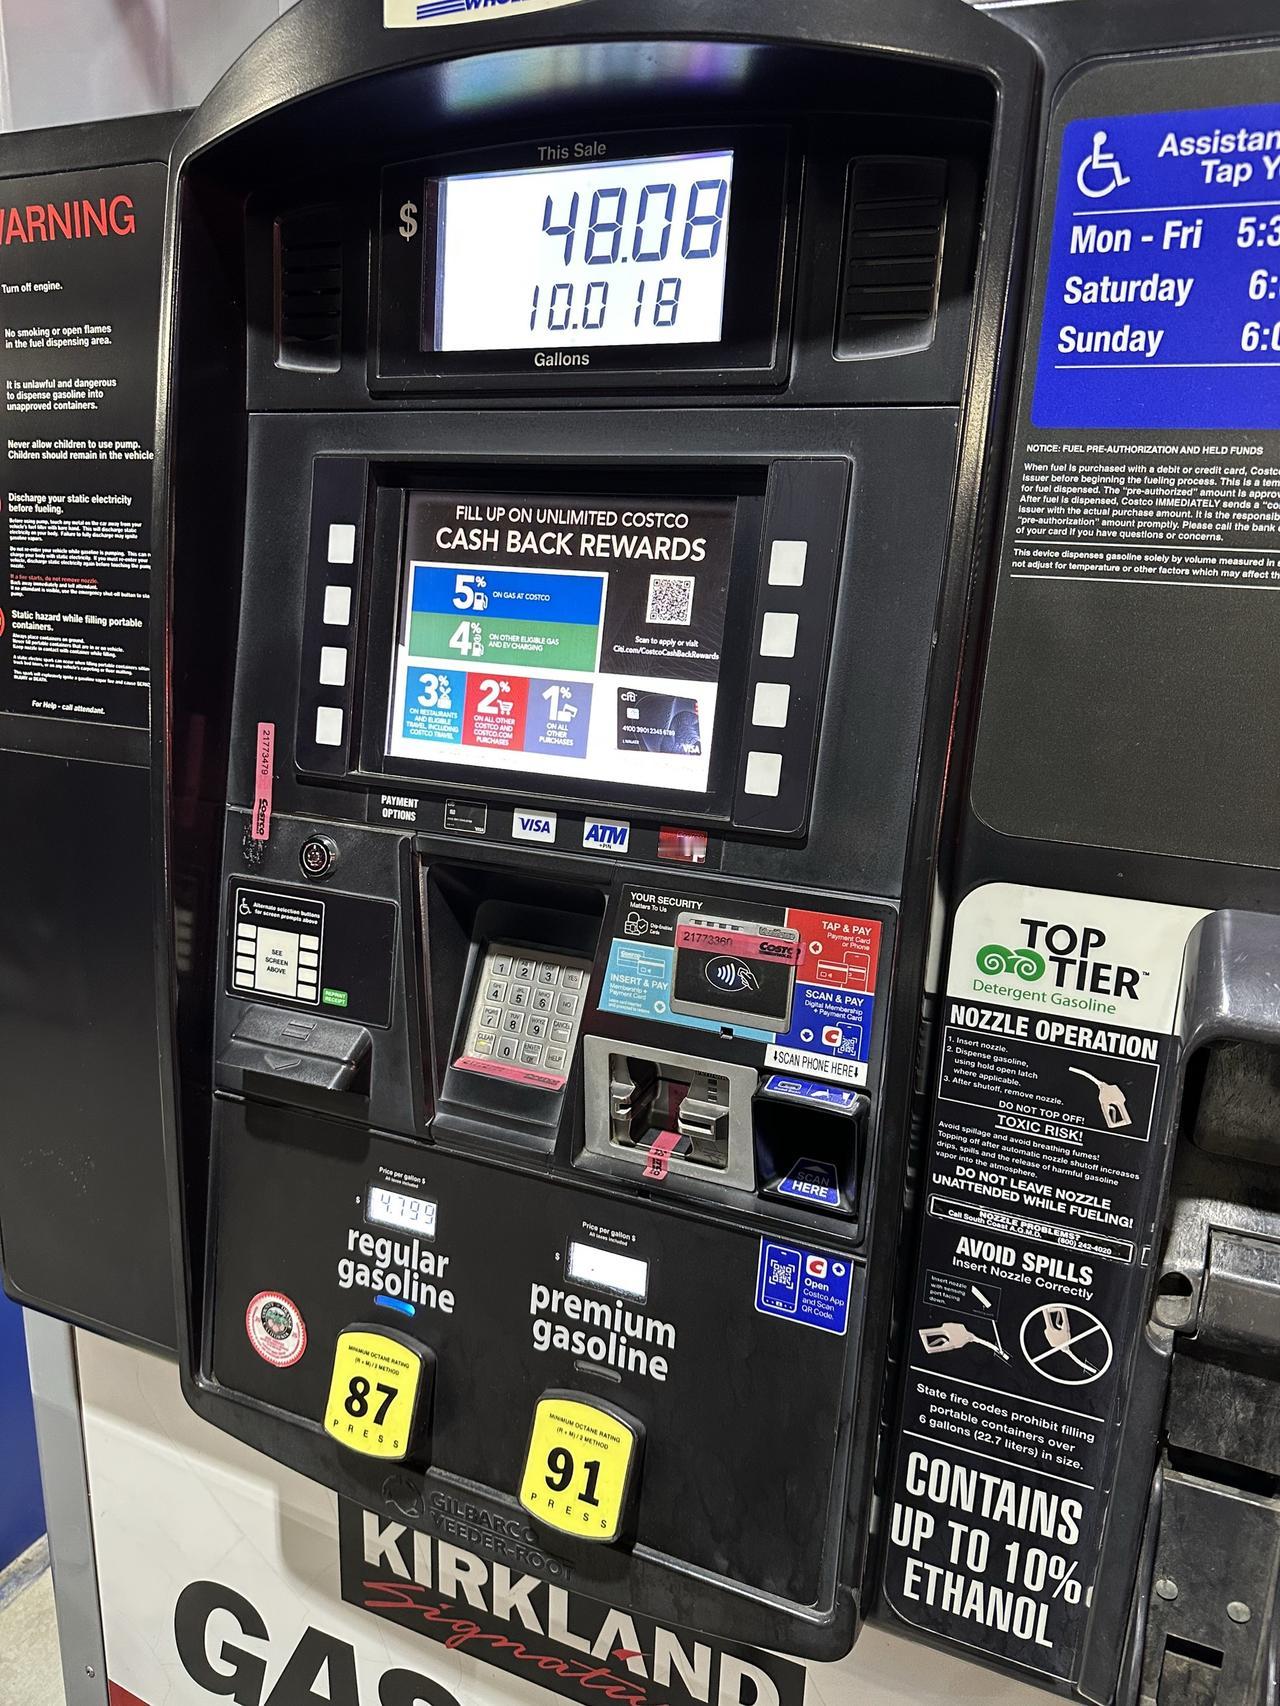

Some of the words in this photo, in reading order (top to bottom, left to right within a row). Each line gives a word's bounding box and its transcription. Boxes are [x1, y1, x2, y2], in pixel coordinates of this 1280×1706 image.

[538, 146, 569, 162] This
[574, 142, 606, 157] Sale
[1200, 160, 1253, 187] Tap
[0, 195, 136, 245] ARNING
[399, 200, 417, 242] $
[542, 179, 728, 266] 48.08
[1070, 225, 1131, 254] Mon
[1162, 219, 1203, 250] Fri
[1, 284, 19, 294] Turn
[21, 283, 32, 292] off
[34, 281, 63, 292] engine.
[1064, 273, 1194, 307] Saturday
[5, 328, 16, 337] No
[18, 327, 50, 339] smoking
[52, 328, 60, 336] or
[62, 327, 82, 337] open
[84, 324, 112, 334] flames
[1058, 325, 1164, 357] Sunday
[534, 353, 590, 367] Gallons
[1026, 444, 1060, 453] NOTICE:
[1063, 445, 1084, 453] FUEL
[1087, 445, 1179, 454] PRE-AUTHORIZATION
[1180, 446, 1200, 454] AND
[1202, 447, 1228, 455] HELD
[1230, 447, 1263, 455] FUNDS
[1024, 463, 1048, 472] When
[1050, 464, 1067, 472] fuel
[1069, 464, 1076, 472] is
[1079, 464, 1126, 475] purchased
[1128, 465, 1146, 473] with
[1157, 465, 1180, 474] debit
[1195, 467, 1221, 475] credit
[1224, 467, 1247, 476] card,
[9, 493, 46, 505] Discharge
[48, 495, 65, 504] your
[67, 494, 89, 503] static
[92, 495, 132, 506] electricity
[9, 504, 32, 513] before
[35, 504, 63, 514] fueling.
[456, 506, 483, 522] FILL
[486, 507, 505, 522] UP
[509, 509, 533, 523] ON
[536, 509, 618, 528] UNLIMITED
[621, 512, 689, 529] COSTCO
[436, 528, 499, 551] CASH
[506, 530, 573, 556] BACK
[580, 534, 707, 562] REWARDS
[493, 591, 501, 599] ON
[525, 593, 550, 602] COSTCO
[635, 636, 649, 644] Scan
[659, 639, 676, 647] apply
[32, 701, 41, 709] For
[43, 701, 57, 710] Help
[62, 703, 72, 711] call
[74, 705, 105, 714] attendant.
[621, 692, 636, 702] citi
[682, 744, 700, 753] VISA
[381, 795, 418, 809] PAYMENT
[382, 808, 416, 822] OPTIONS
[518, 817, 551, 834] VISA
[585, 824, 627, 845] ATM
[630, 892, 655, 904] YOUR
[657, 896, 703, 910] SECURITY
[822, 921, 841, 932] TAP
[844, 924, 851, 933] &
[853, 926, 872, 936] PAY
[1020, 918, 1106, 959] TOP
[265, 957, 288, 968] SCREEN
[266, 966, 286, 975] ABOVE
[611, 974, 642, 986] INSERT
[644, 978, 650, 987] &
[651, 981, 668, 991] PAY
[805, 989, 834, 1002] SCAN
[836, 995, 844, 1004] &
[846, 996, 864, 1007] PAY
[973, 979, 1047, 1003] Detergent
[1051, 993, 1116, 1015] Gasoline
[950, 1004, 1029, 1037] NOZZLE
[1035, 1020, 1158, 1060] OPERATION
[778, 1052, 800, 1066] SCAN
[802, 1056, 830, 1072] PHONE
[831, 1062, 854, 1078] HERE
[999, 1100, 1014, 1110] DO
[1016, 1103, 1038, 1115] NOT
[1040, 1109, 1060, 1120] TOP
[1062, 1113, 1085, 1124] OFF!
[997, 1114, 1041, 1133] TOXIC
[1045, 1124, 1084, 1142] RISK!
[379, 1167, 393, 1175] Price
[404, 1174, 421, 1183] gallon
[792, 1180, 828, 1198] HERE
[956, 1166, 975, 1179] DO
[978, 1171, 1006, 1187] NOT
[1010, 1178, 1052, 1197] LEAVE
[1055, 1188, 1111, 1210] NOZZLE
[933, 1173, 1020, 1203] UNATTENDED
[1023, 1194, 1066, 1214] WHILE
[1069, 1205, 1134, 1229] FUELING!
[347, 1229, 450, 1279] regular
[956, 1236, 1016, 1267] AVOID
[1022, 1252, 1093, 1286] SPILLS
[338, 1257, 455, 1314] gasoline
[804, 1278, 829, 1292] Open
[953, 1256, 987, 1274] Insert
[990, 1265, 1031, 1284] Nozzle
[1035, 1277, 1094, 1301] Correctly
[802, 1297, 815, 1307] and
[816, 1300, 834, 1312] Scan
[803, 1288, 829, 1301] Costco
[830, 1296, 844, 1307] App
[530, 1282, 677, 1350] premium
[802, 1305, 813, 1314] QR
[814, 1308, 834, 1320] Code.
[532, 1320, 668, 1381] gasoline
[345, 1376, 398, 1426] 87
[916, 1384, 947, 1400] State
[950, 1392, 969, 1406] fire
[972, 1397, 1008, 1418] codes
[1011, 1411, 1058, 1432] prohibit
[1061, 1424, 1095, 1444] filling
[333, 1419, 398, 1448] PRESS
[545, 1447, 600, 1507] 91
[531, 1493, 607, 1528] PRESS
[906, 1451, 1083, 1546] CONTAINS
[431, 1491, 538, 1542] GILBARCO
[890, 1502, 935, 1552] UP
[948, 1520, 990, 1573] TO
[1005, 1541, 1082, 1605] 10%
[362, 1510, 780, 1706] KIRKLAND
[902, 1556, 1054, 1648] ETHANOL
